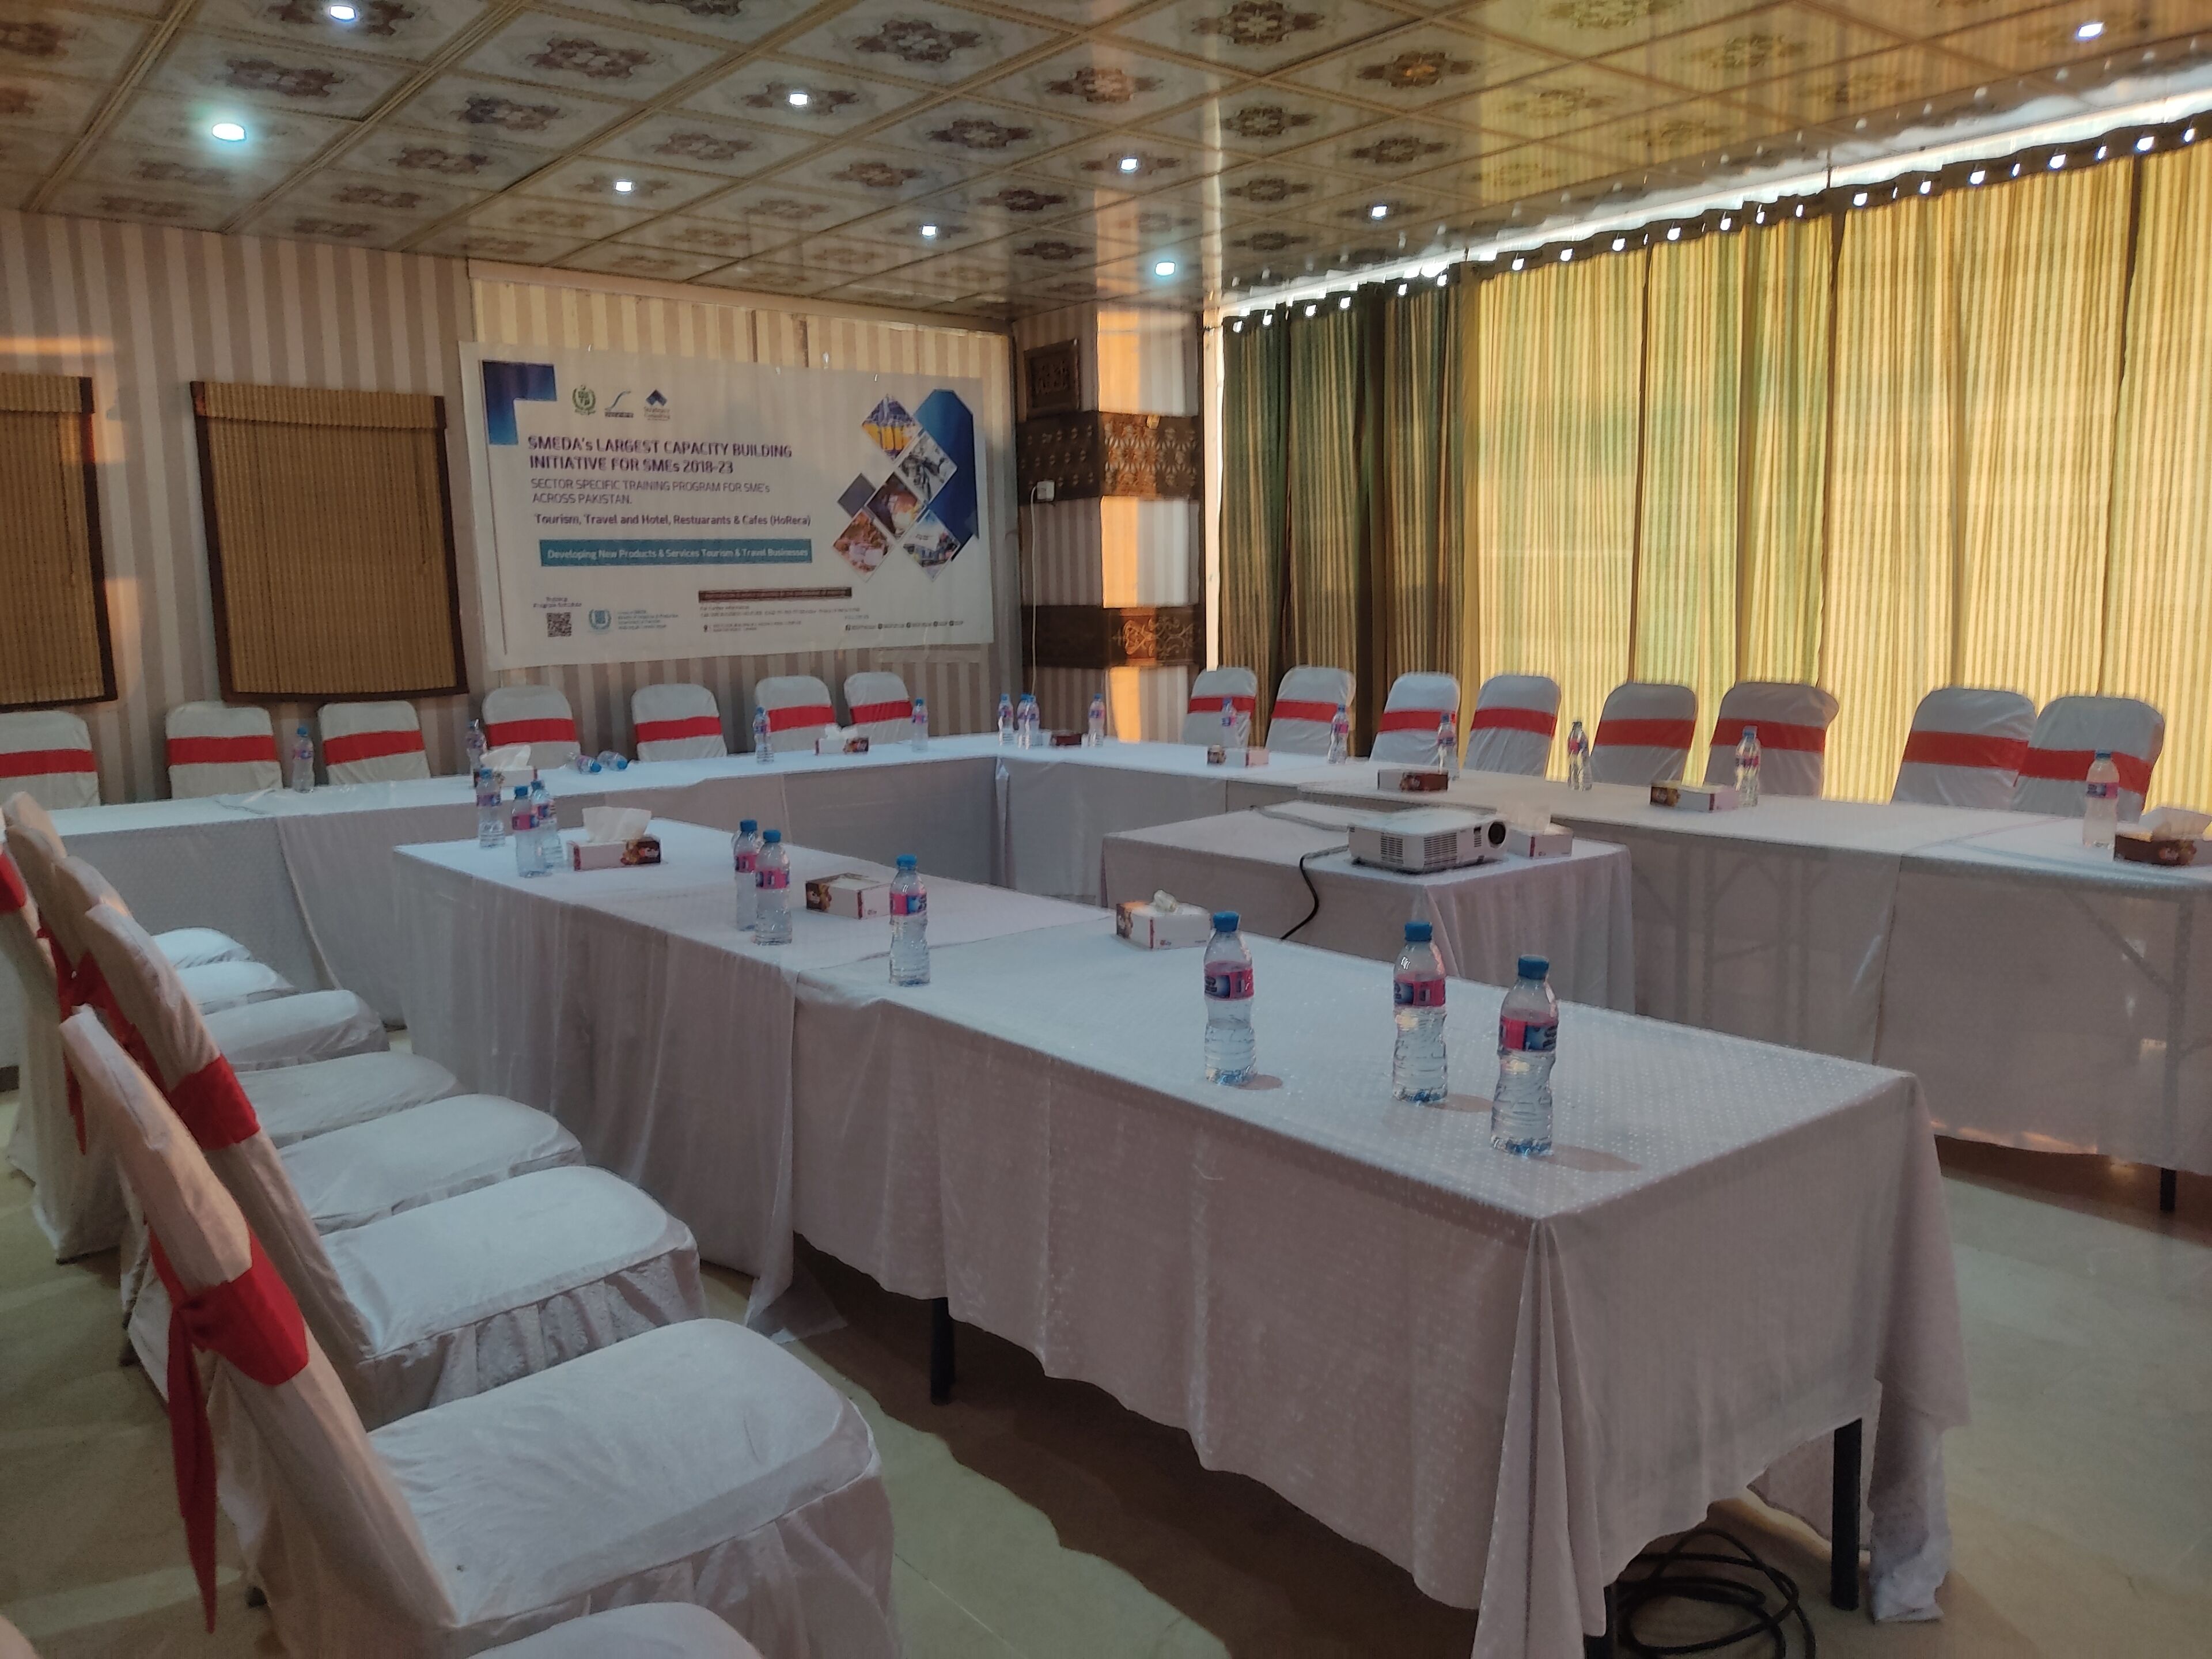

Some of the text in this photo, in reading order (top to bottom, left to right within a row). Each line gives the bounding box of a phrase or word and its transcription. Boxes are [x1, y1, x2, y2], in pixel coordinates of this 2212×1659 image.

[528, 435, 792, 457] SMEDA's LARGEST CAPACITY BUILDING
[530, 455, 733, 474] INITIATIVE FOR SMEs 2018-23
[531, 479, 573, 489] SECTOR
[576, 479, 620, 490] SPECIFIC
[623, 480, 669, 491] TRAINING
[672, 482, 720, 492] PROGRAM
[723, 483, 742, 492] FOR
[532, 493, 632, 505] ACROSS PAKISTAN.
[536, 514, 582, 525] Tourism,
[584, 514, 618, 525] Travel
[620, 515, 639, 525] and
[642, 515, 671, 525] Hotel,
[673, 515, 731, 525] Restuarants
[734, 516, 740, 525] &
[743, 516, 768, 525] Cafes
[548, 549, 597, 560] Developing
[599, 550, 618, 558] New
[619, 549, 657, 558] Products
[659, 550, 665, 558] &
[666, 549, 700, 558] Services
[702, 548, 734, 558] Tourism
[736, 548, 741, 557] &
[743, 548, 766, 557] Travel
